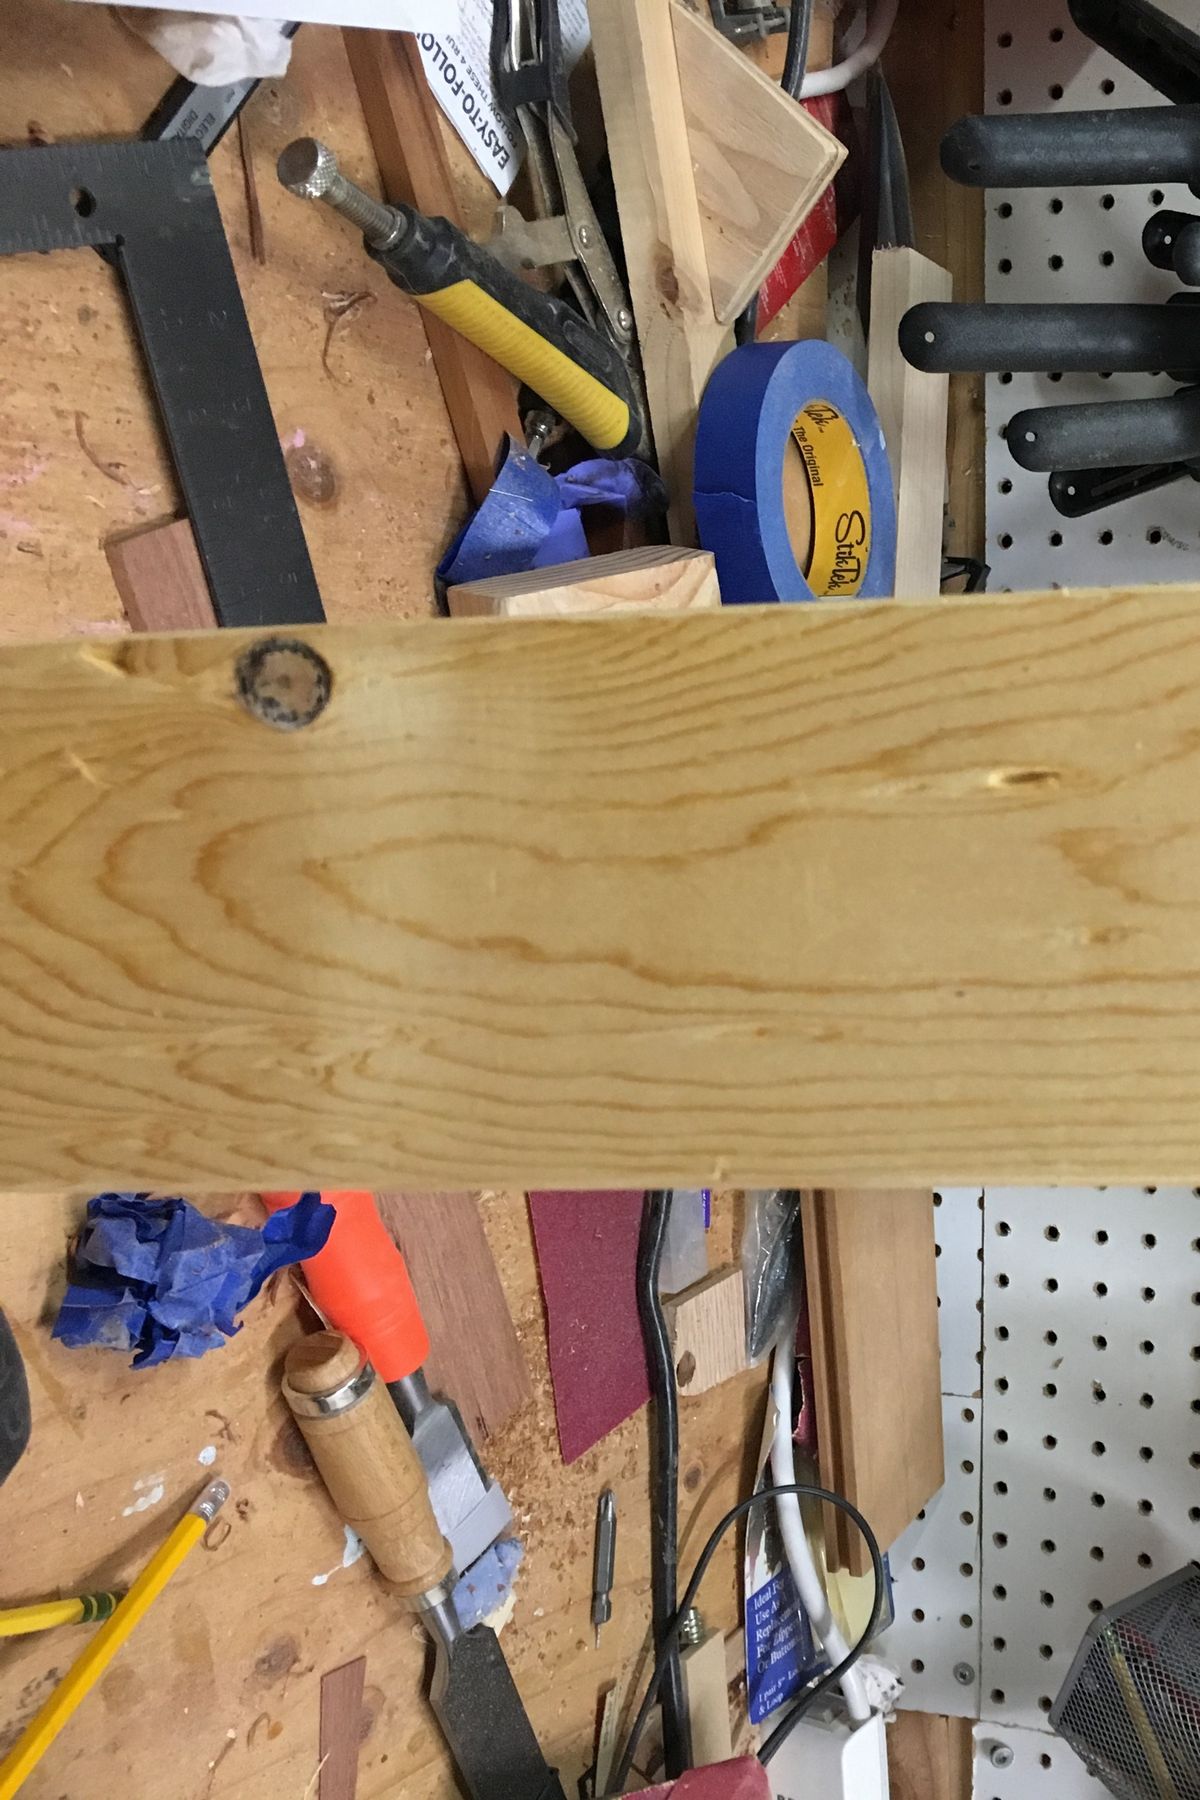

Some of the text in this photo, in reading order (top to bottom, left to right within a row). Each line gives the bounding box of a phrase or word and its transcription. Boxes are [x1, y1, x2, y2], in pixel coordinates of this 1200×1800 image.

[465, 65, 488, 103] THESE
[793, 426, 825, 487] The Original
[828, 510, 867, 591] StikTek
[753, 1586, 772, 1610] Ideal
[755, 1608, 770, 1626] Use
[764, 1685, 777, 1701] pair
[766, 1692, 784, 1710] Loop
